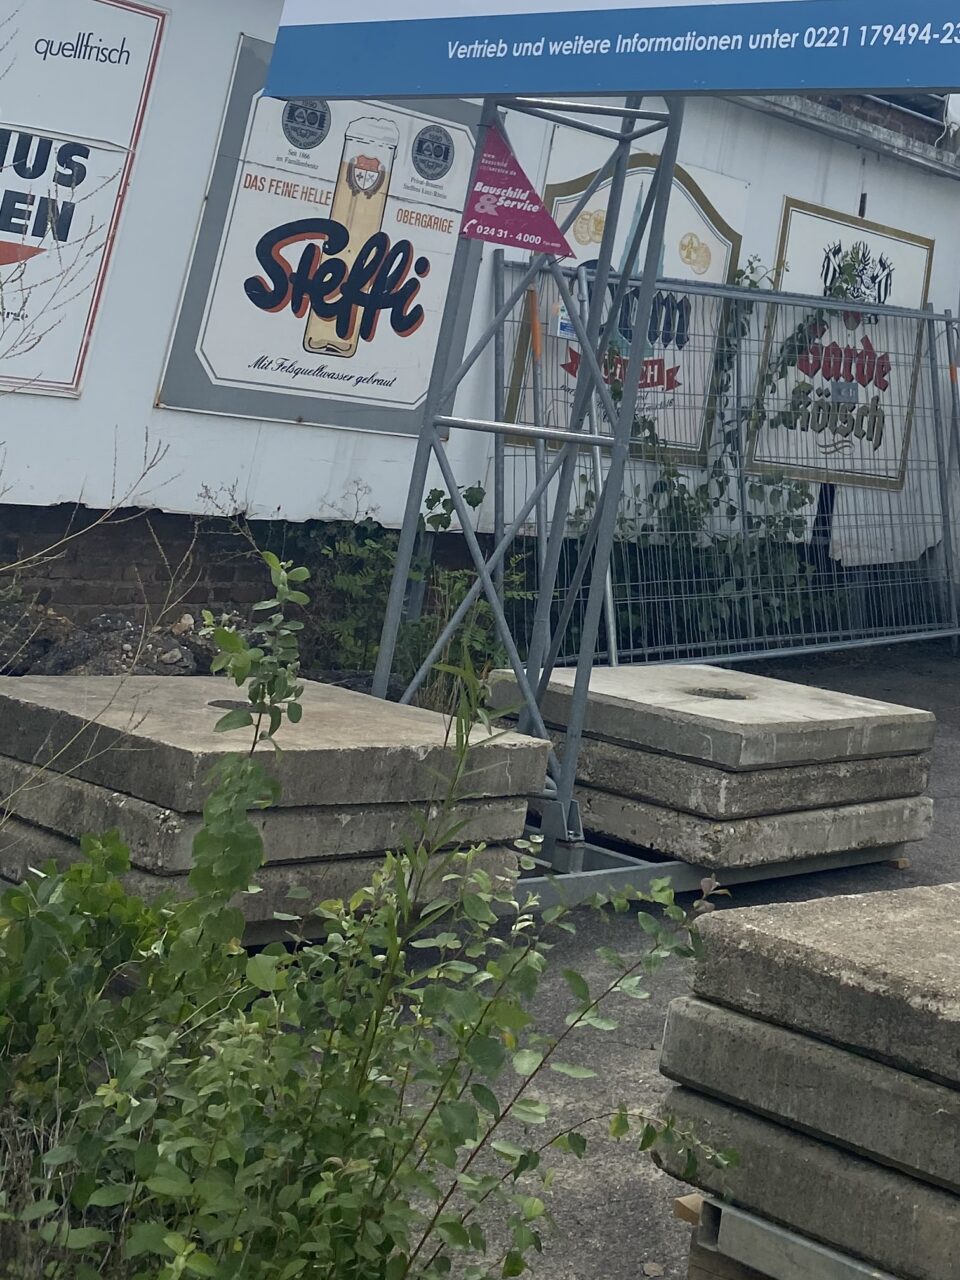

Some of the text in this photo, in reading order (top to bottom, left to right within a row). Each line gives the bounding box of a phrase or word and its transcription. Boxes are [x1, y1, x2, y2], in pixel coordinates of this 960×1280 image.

[34, 32, 131, 65] quellfrisch
[447, 38, 508, 59] Vertrieb
[512, 37, 545, 57] und
[548, 35, 611, 55] weitere
[615, 30, 742, 53] Informationen
[748, 28, 799, 49] unter
[803, 25, 849, 48] 0221
[243, 173, 333, 207] DAS FEINE HELLE
[474, 182, 529, 201] Bauschild
[496, 196, 540, 213] Service
[396, 208, 454, 234] OBERGÄRIGE
[244, 218, 430, 342] Steffi
[248, 355, 398, 388] Mit Felsquellwasser gebraut
